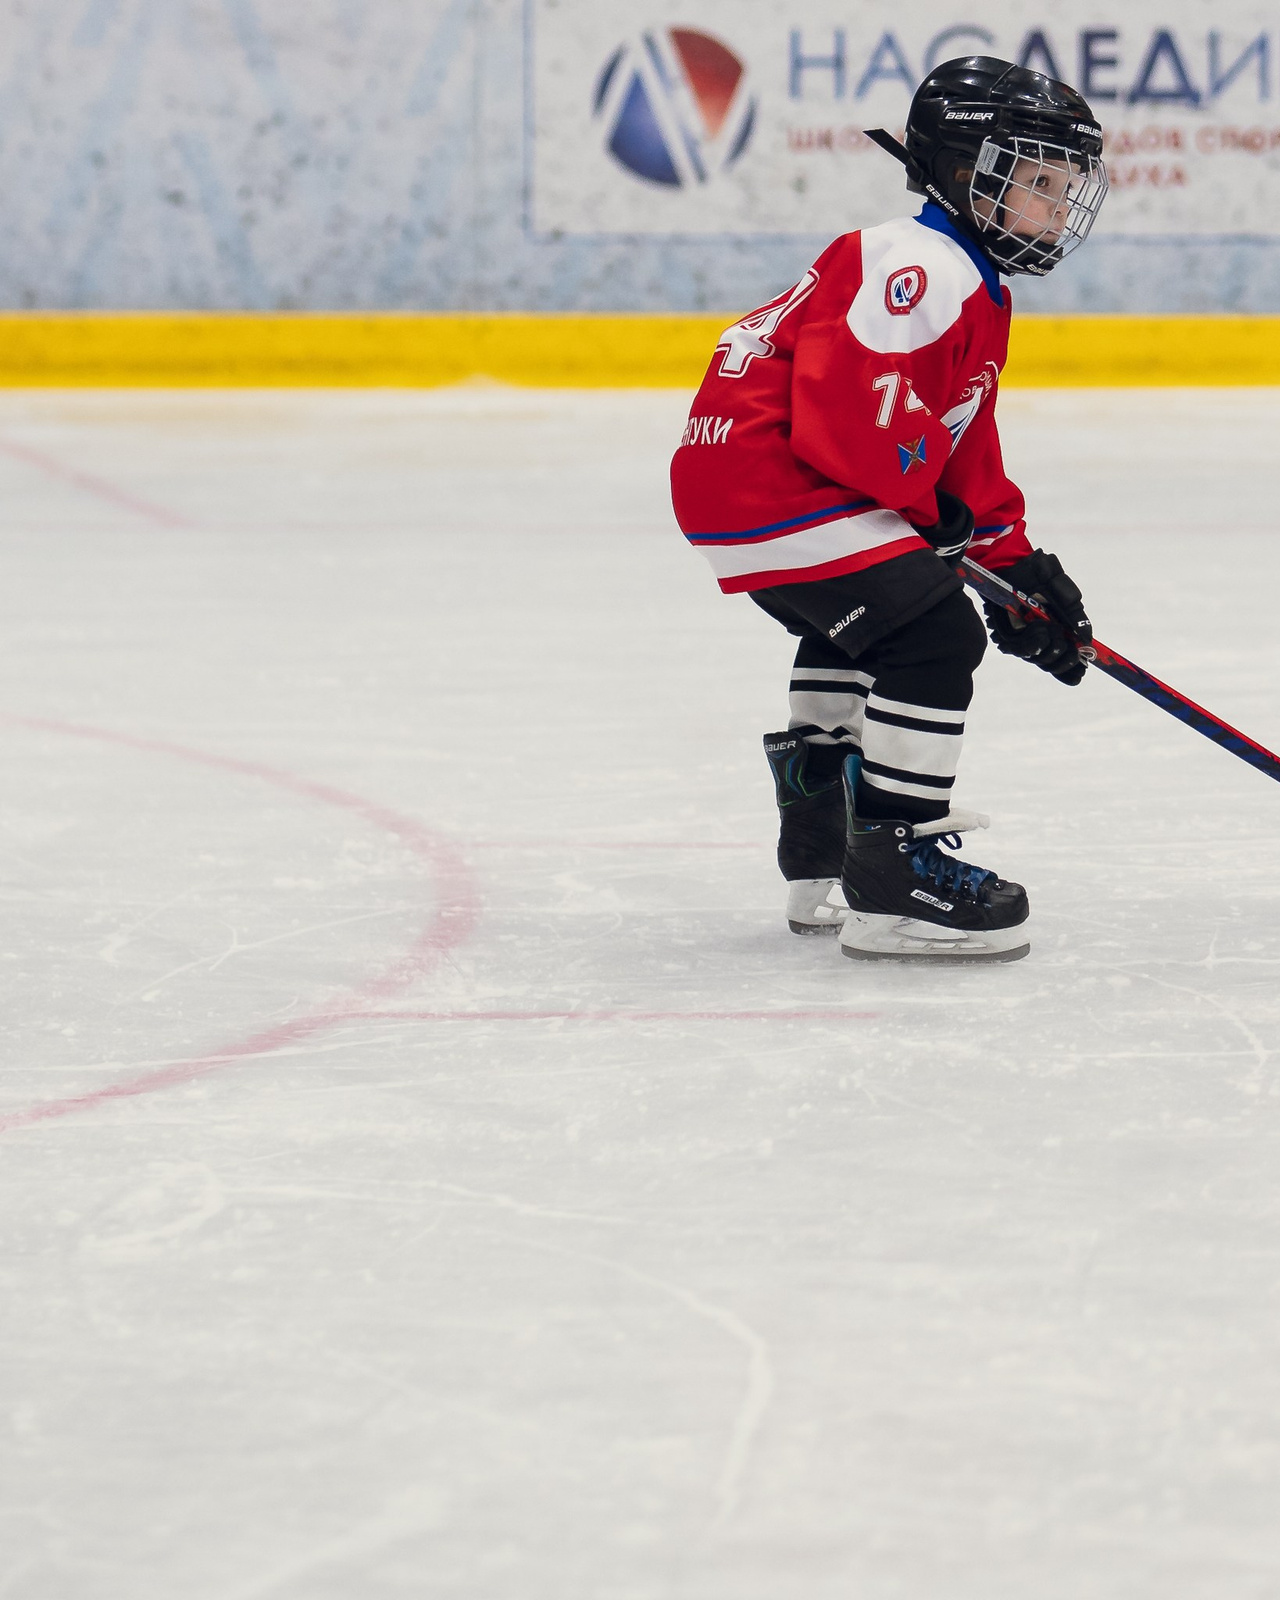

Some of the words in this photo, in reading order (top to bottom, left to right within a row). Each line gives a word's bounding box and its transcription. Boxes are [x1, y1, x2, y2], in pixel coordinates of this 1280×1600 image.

[945, 111, 994, 121] BAUER
[925, 184, 959, 216] BAUER
[828, 605, 866, 638] BAUER
[912, 890, 952, 911] BAUER
